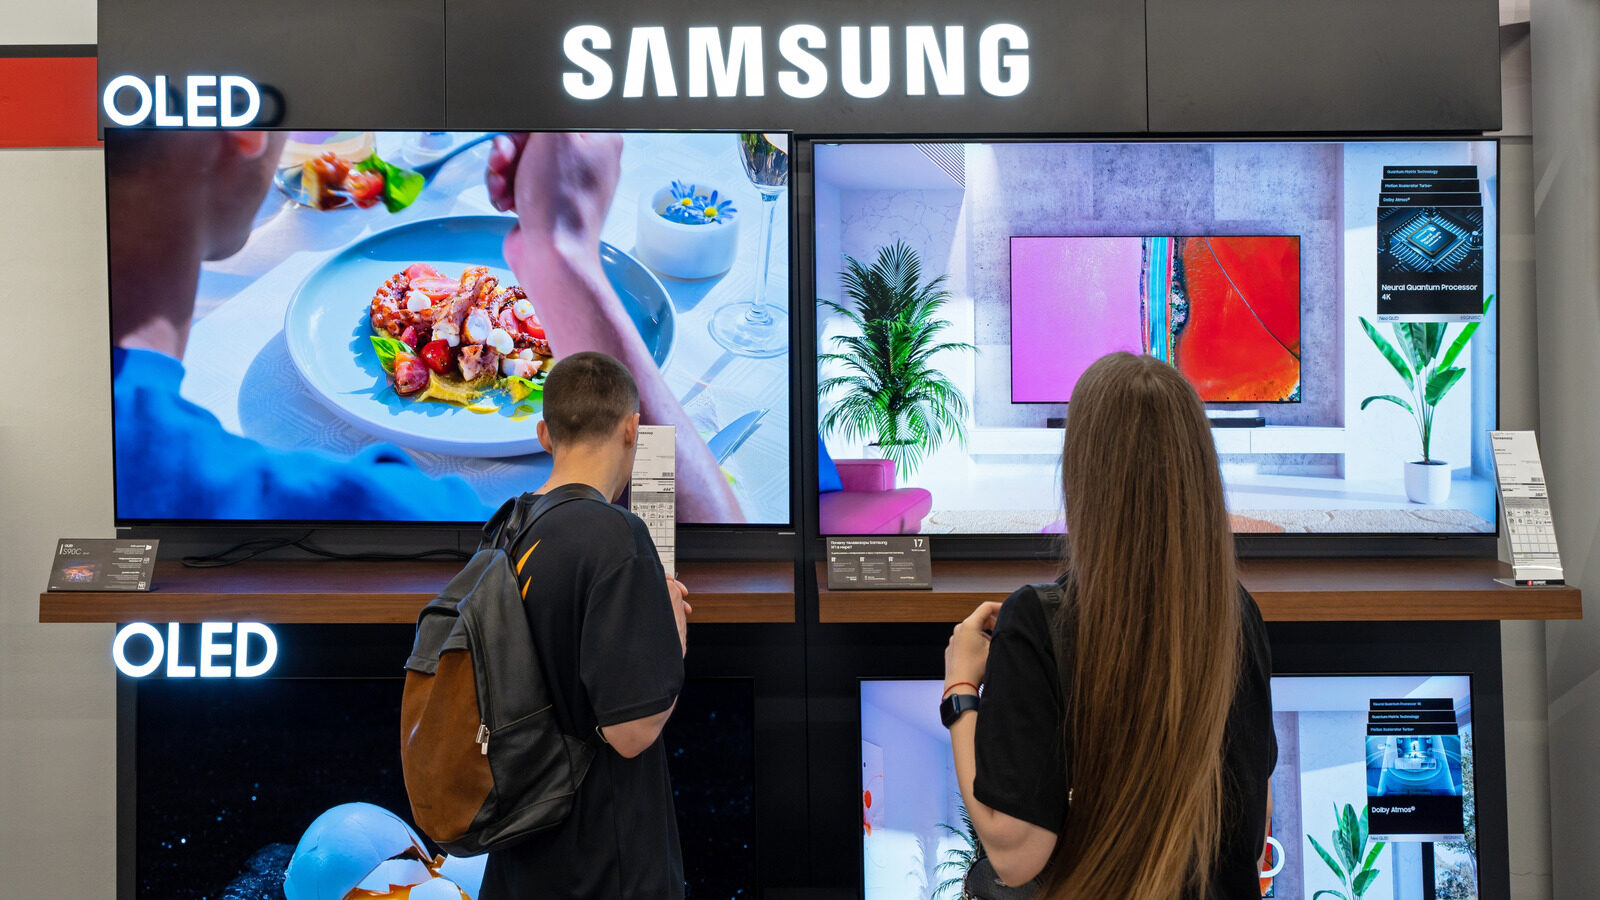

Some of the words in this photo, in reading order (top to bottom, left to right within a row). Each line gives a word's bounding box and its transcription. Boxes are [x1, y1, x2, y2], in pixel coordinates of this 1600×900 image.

[562, 24, 1030, 100] SAMSUNG
[103, 75, 260, 127] OLED
[1381, 293, 1391, 301] 4K
[913, 538, 924, 548] 17
[62, 547, 83, 555] S90C
[112, 622, 278, 678] OLED
[1371, 806, 1390, 815] Dolby
